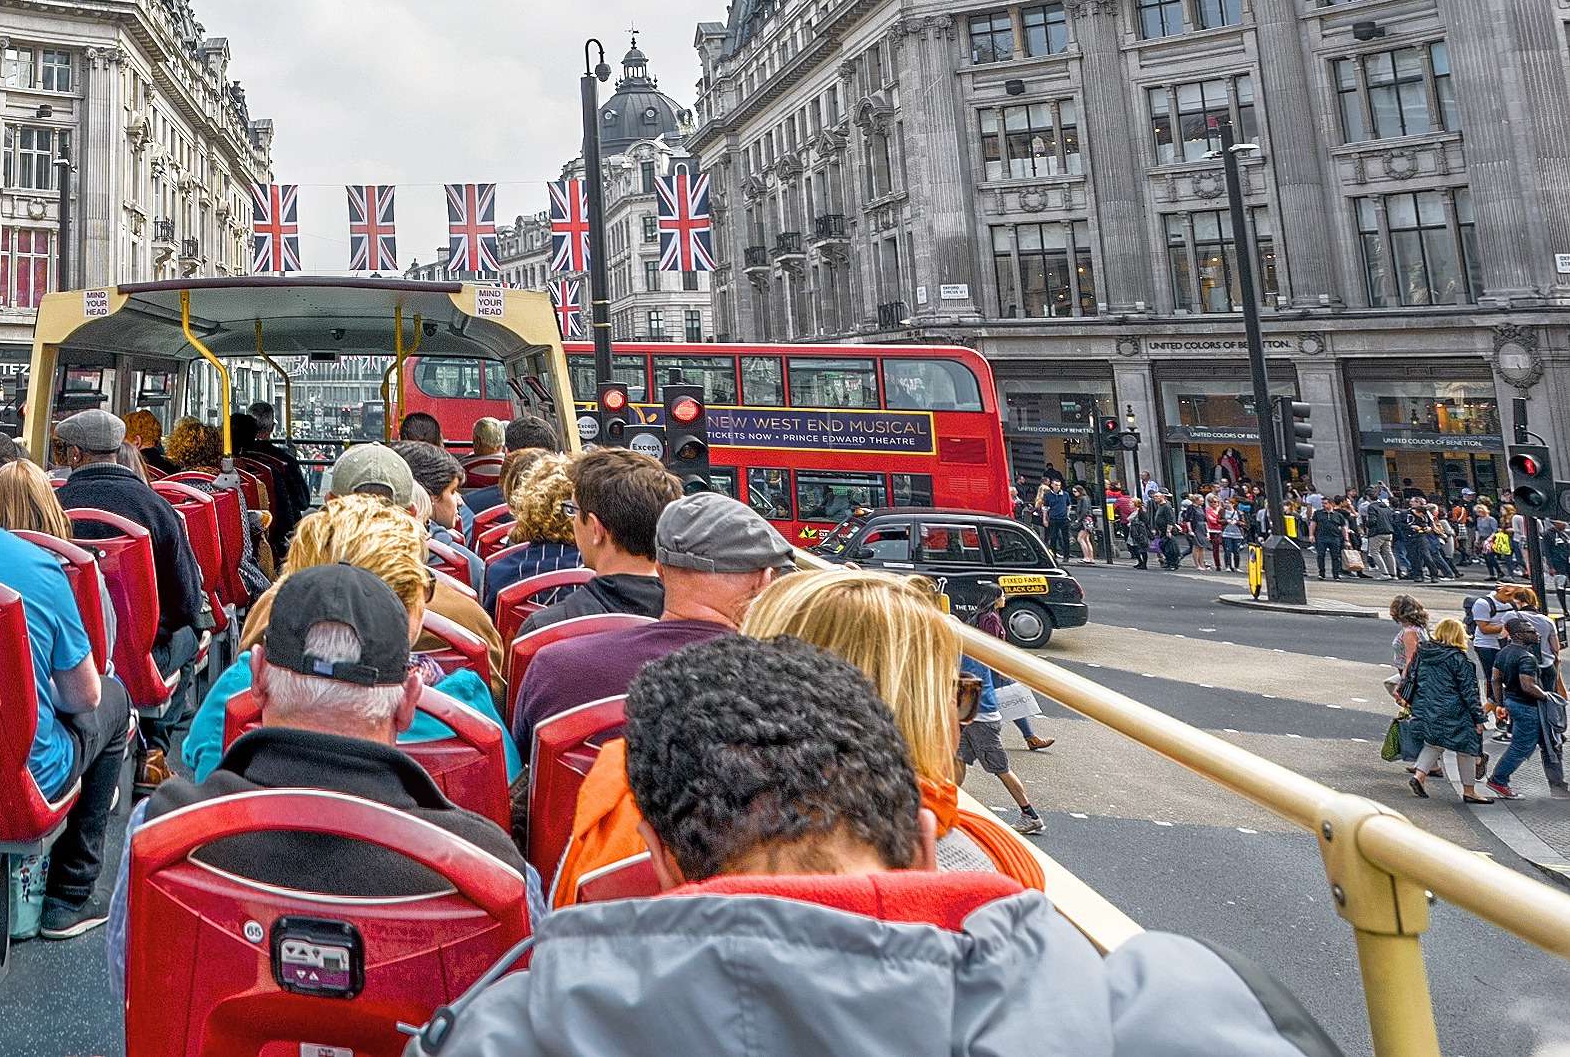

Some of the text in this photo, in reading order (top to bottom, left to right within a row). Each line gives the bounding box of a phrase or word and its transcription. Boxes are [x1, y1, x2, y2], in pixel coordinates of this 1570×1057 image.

[479, 289, 501, 297] MIND
[1149, 340, 1291, 350] UNITED COLORS OF BETTON.
[708, 416, 927, 435] NEW WEST END MUSICAL
[706, 431, 745, 440] TICKETS
[748, 432, 772, 440] NOW
[783, 434, 819, 442] PRINCE
[822, 435, 866, 444] EDWARD
[869, 436, 916, 446] THEATRE
[632, 444, 660, 452] Except
